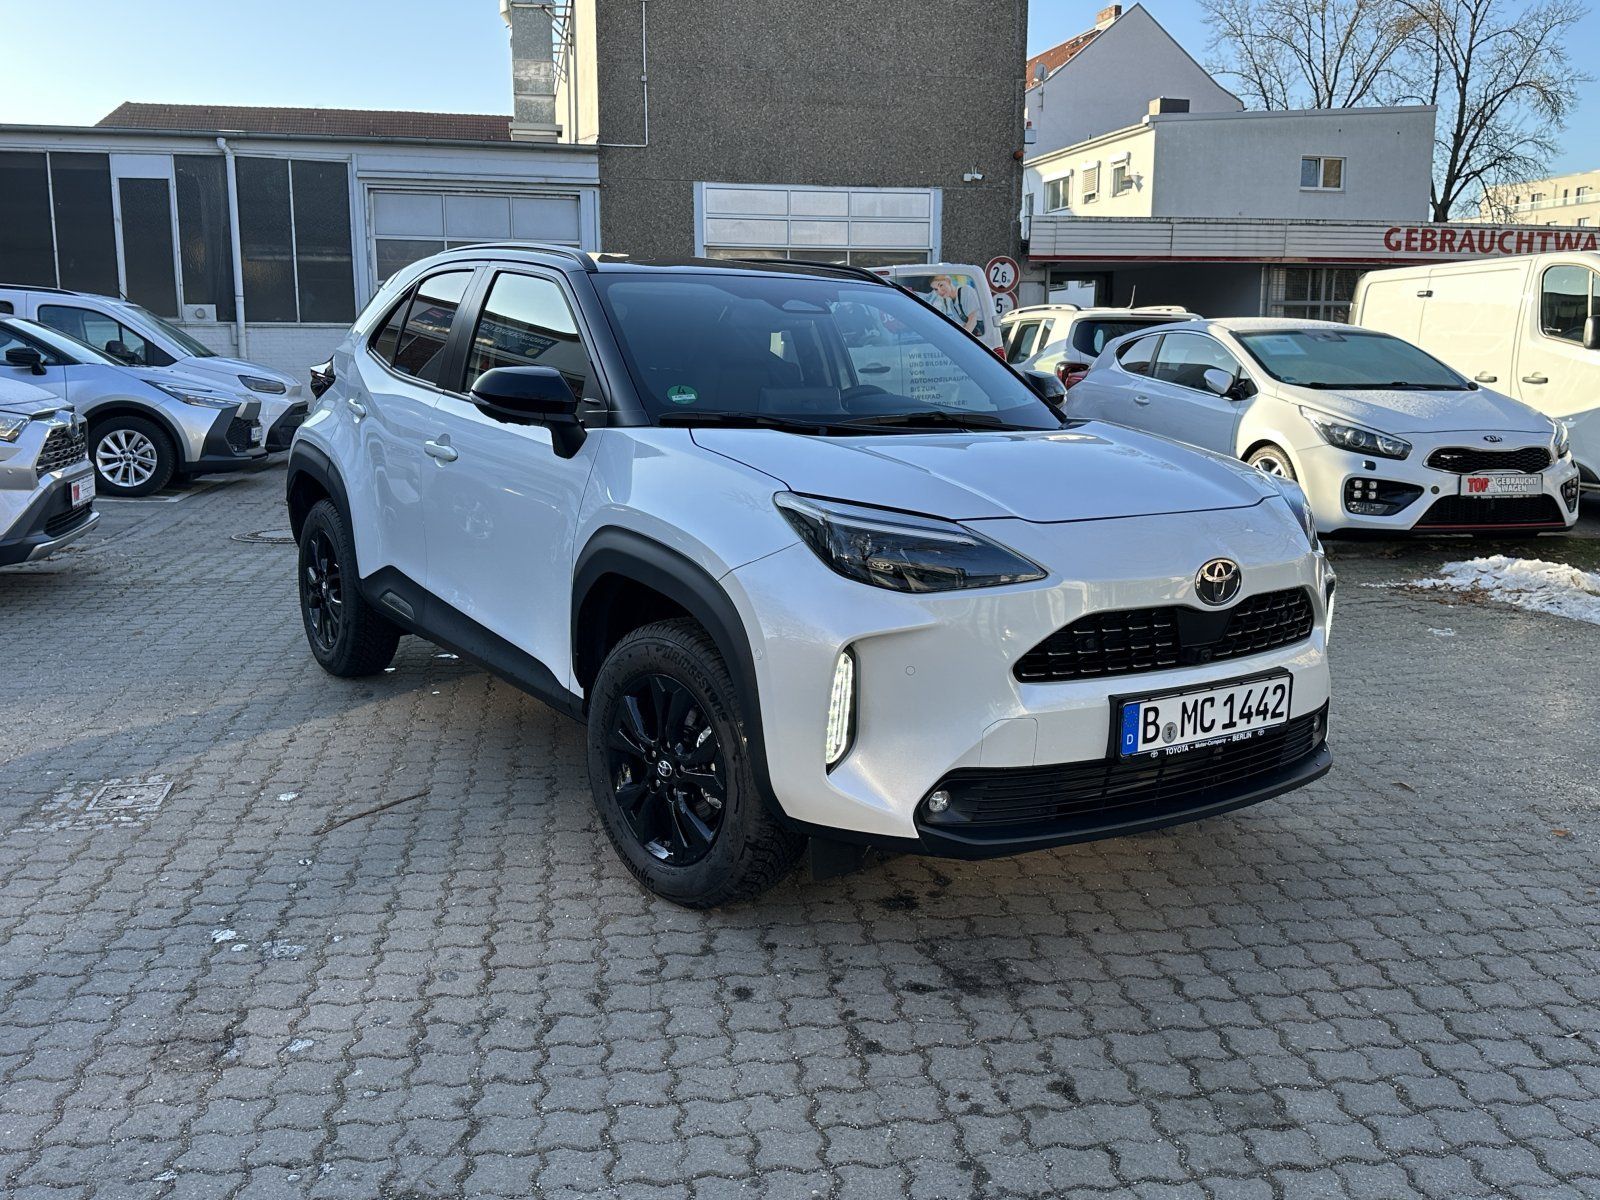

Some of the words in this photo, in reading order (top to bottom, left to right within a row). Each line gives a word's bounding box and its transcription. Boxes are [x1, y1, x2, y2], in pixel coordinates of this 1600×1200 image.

[1496, 477, 1538, 486] GEBRAUCHT
[1502, 484, 1528, 493] WAGEN
[1142, 706, 1160, 744] B
[1181, 697, 1215, 738] MC
[1221, 683, 1286, 730] 1442
[1126, 734, 1134, 746] D
[1165, 744, 1189, 756] TOYOTA
[1232, 731, 1252, 742] BERLIN
